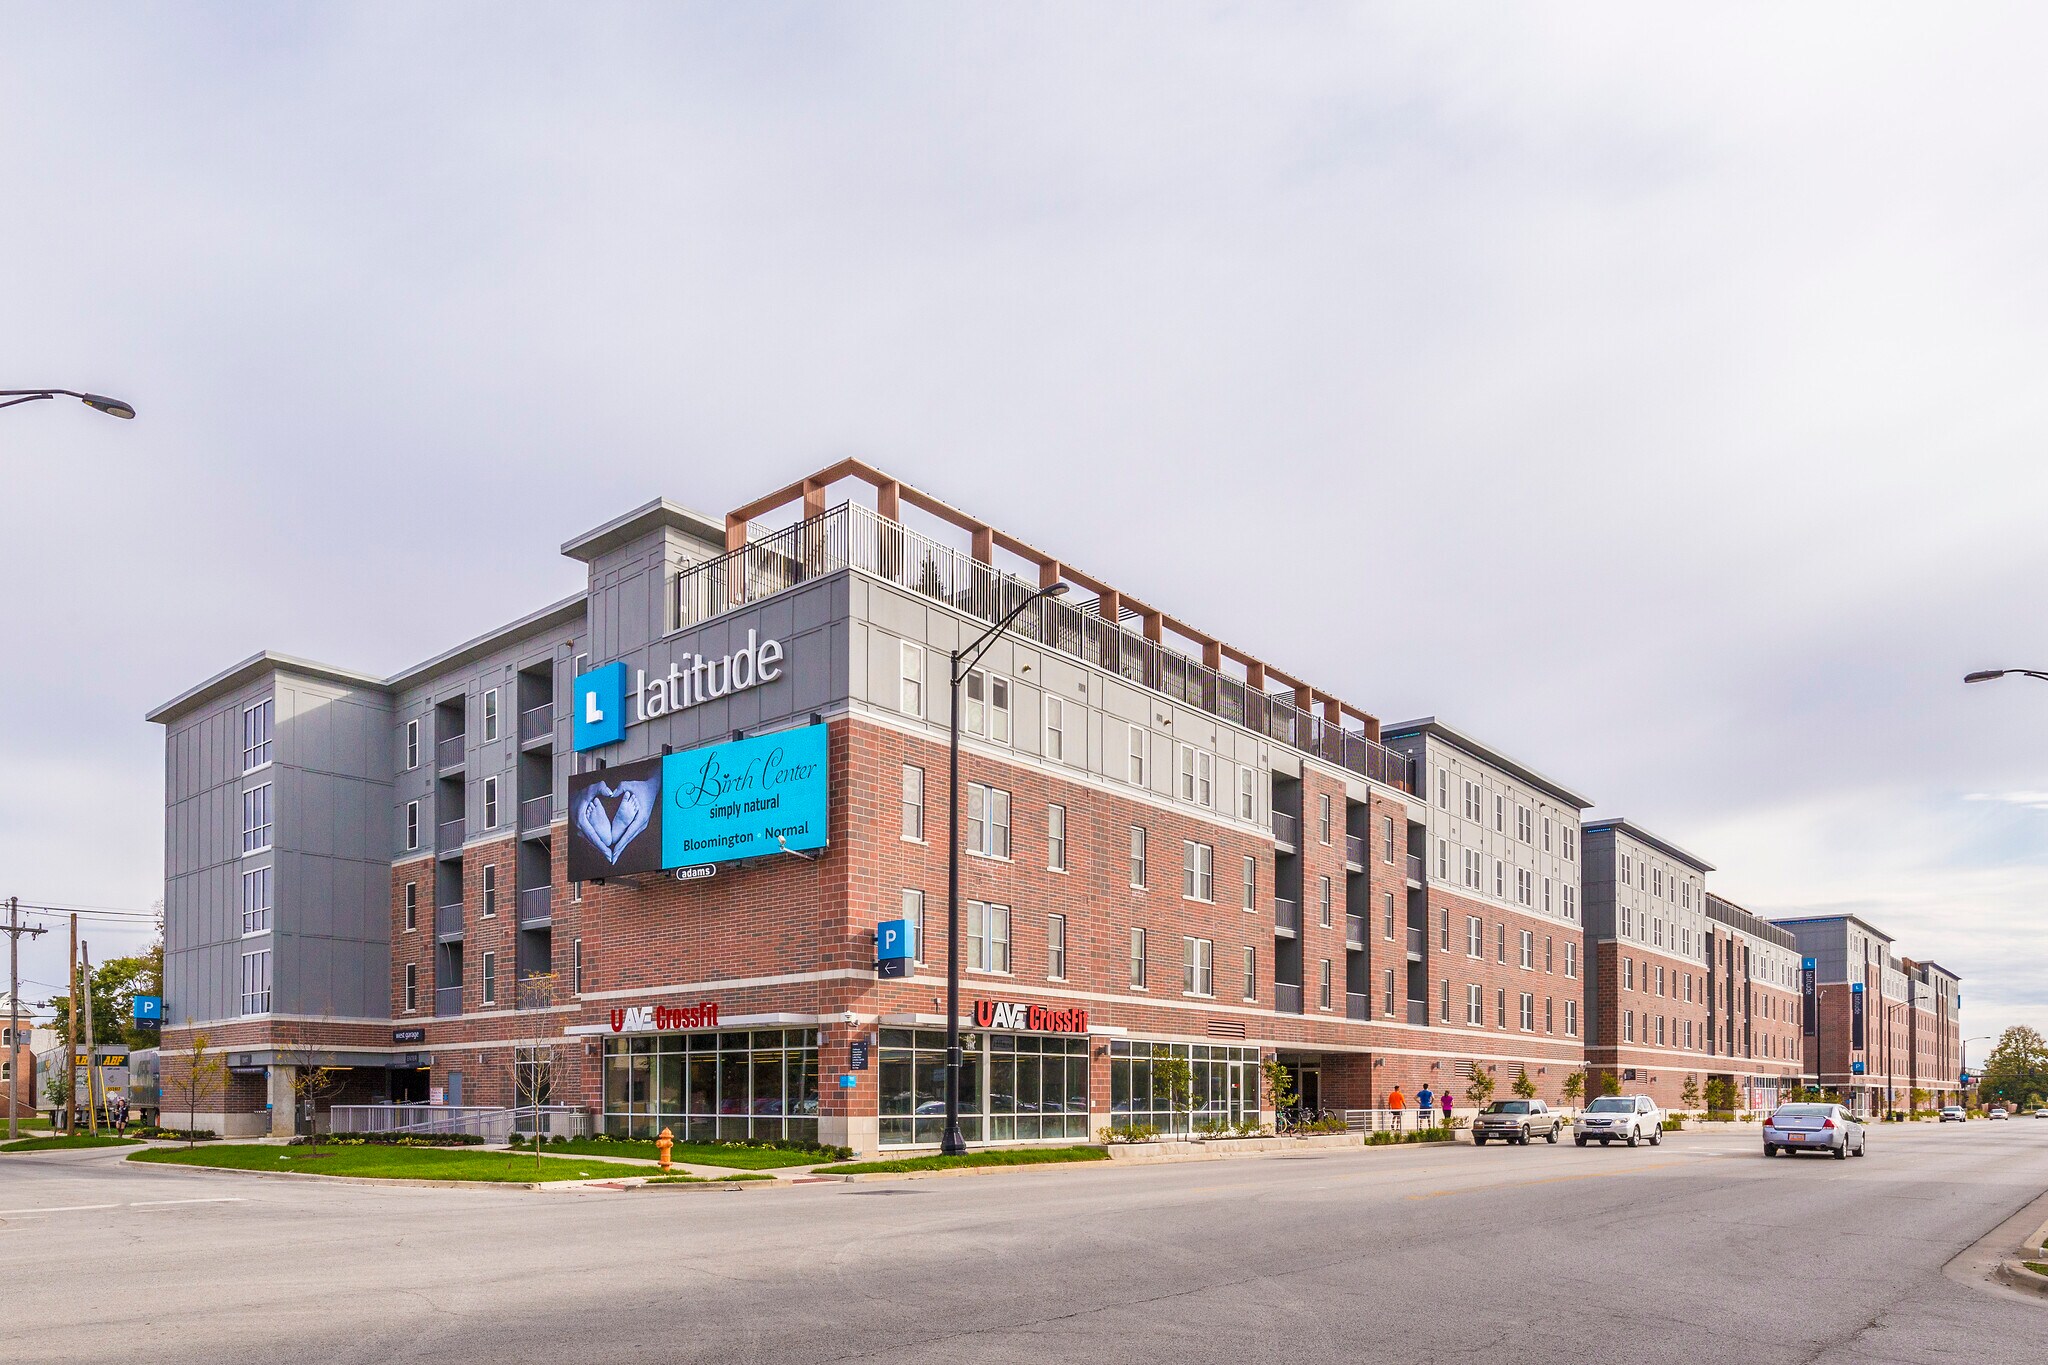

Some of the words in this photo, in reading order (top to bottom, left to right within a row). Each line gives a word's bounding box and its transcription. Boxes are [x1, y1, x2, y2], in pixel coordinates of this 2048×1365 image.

[637, 628, 783, 721] latitude
[586, 691, 604, 724] L
[675, 751, 761, 809] Birth
[762, 747, 818, 790] Center
[709, 801, 741, 819] simply
[743, 794, 780, 815] natural
[683, 831, 754, 852] Bloomington
[765, 821, 809, 840] Normal
[681, 867, 711, 879] adams
[886, 929, 897, 950] P
[1805, 970, 1814, 995] latitude
[144, 1001, 154, 1013] P
[656, 1002, 719, 1030] CrossFit
[1029, 1004, 1088, 1032] CrossFit
[405, 1031, 419, 1040] garage
[103, 1055, 124, 1066] ABF
